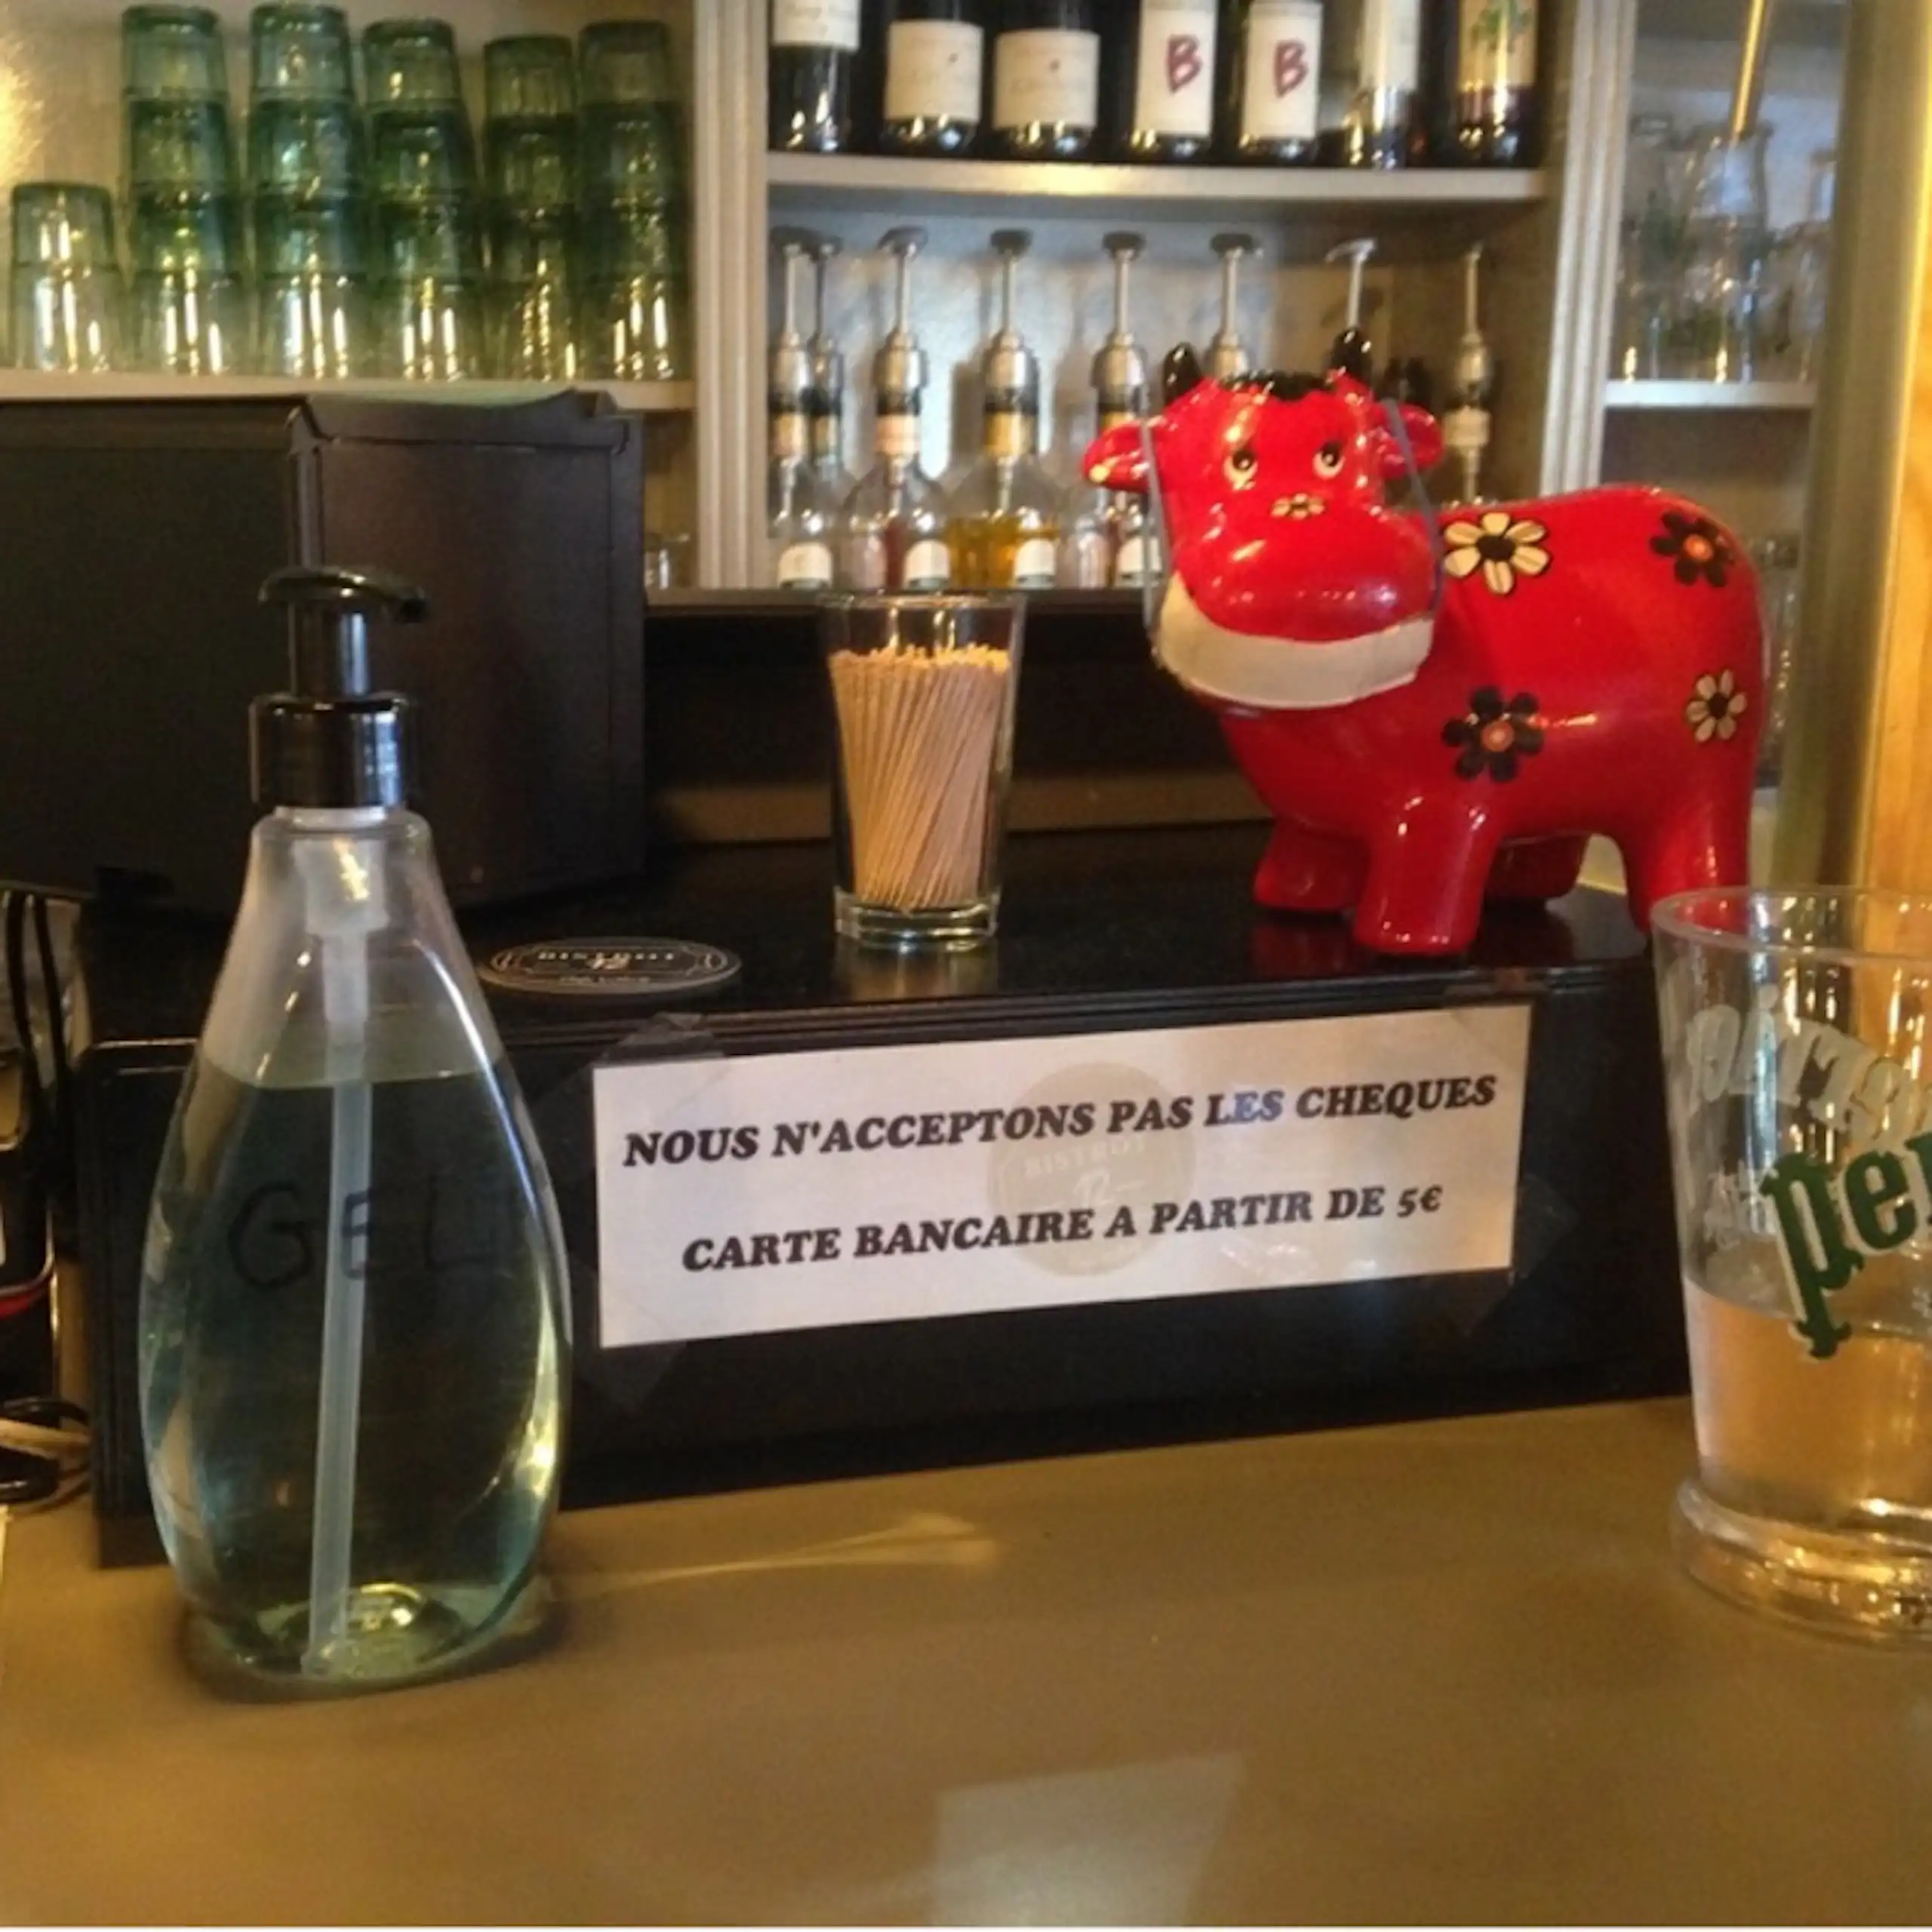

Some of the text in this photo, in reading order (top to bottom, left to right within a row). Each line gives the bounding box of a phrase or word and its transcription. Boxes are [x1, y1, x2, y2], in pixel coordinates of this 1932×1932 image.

[1165, 33, 1203, 94] B
[1273, 38, 1309, 98] B
[623, 1075, 1497, 1168] NOUS N'ACCEPTONS PAS LES CHEQUES
[229, 1174, 501, 1288] GEL
[681, 1185, 1443, 1272] CARTE BANCAIRE A PARTIR DE 5€
